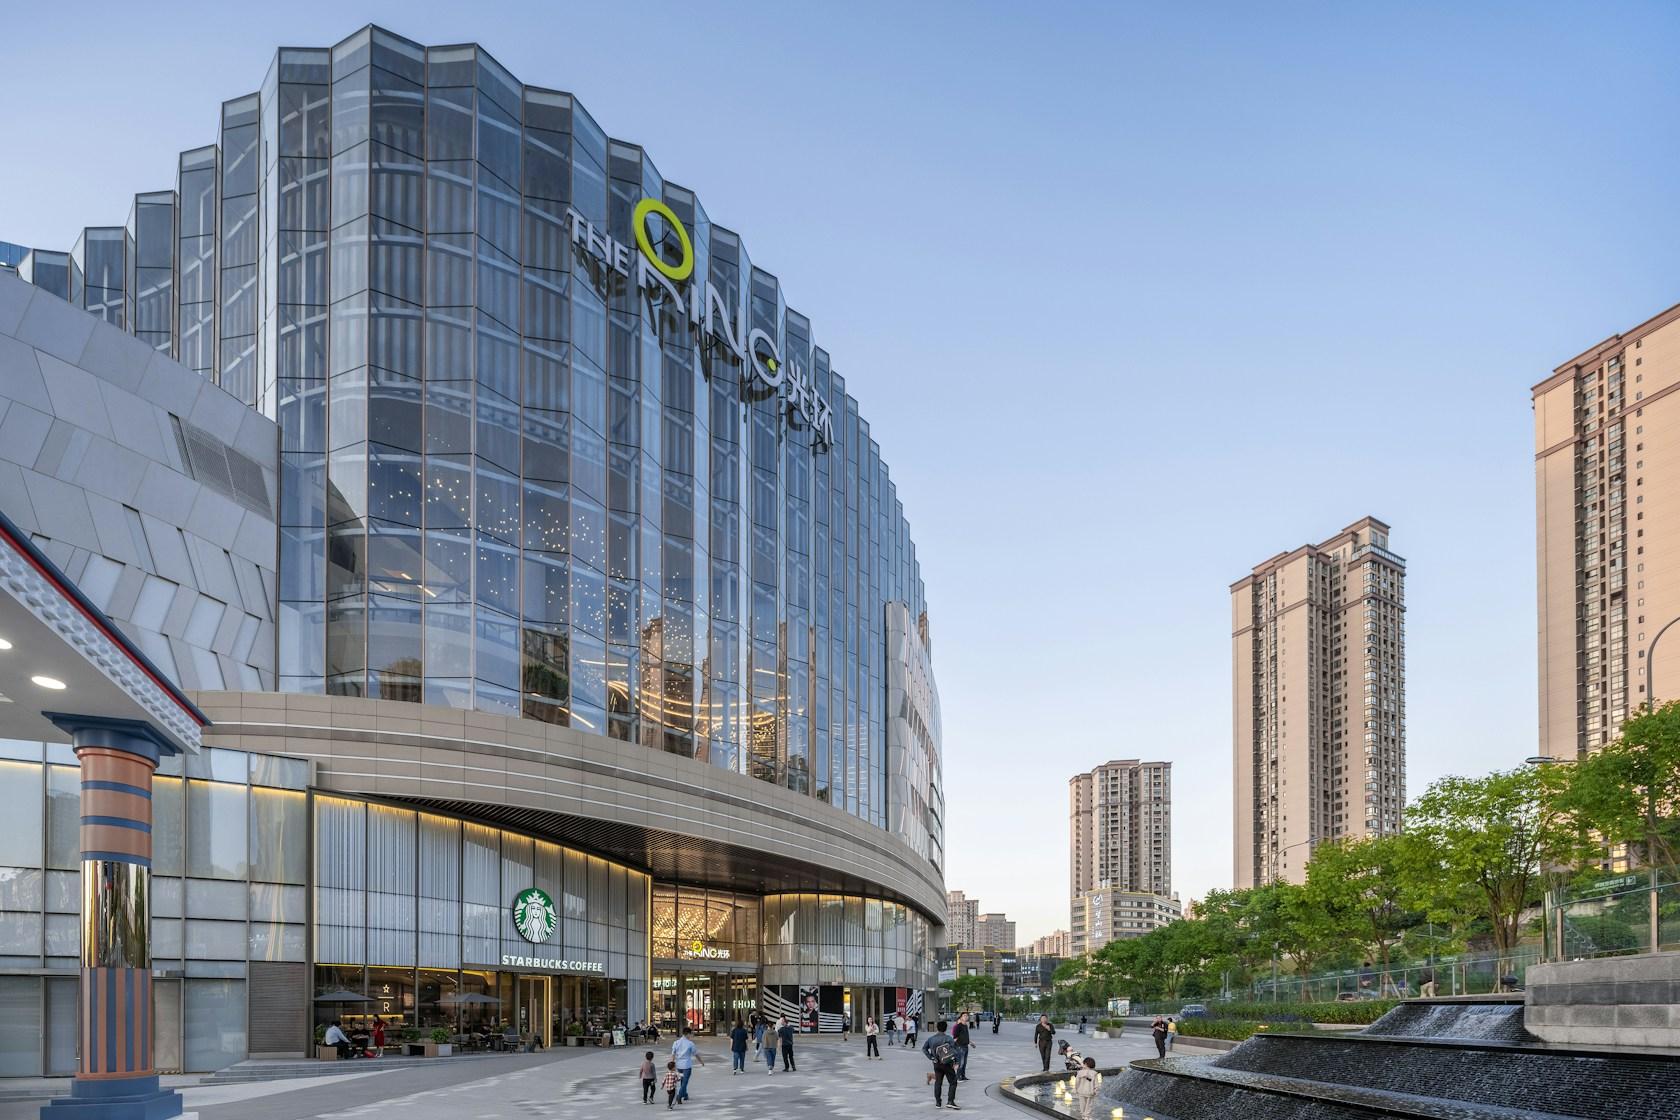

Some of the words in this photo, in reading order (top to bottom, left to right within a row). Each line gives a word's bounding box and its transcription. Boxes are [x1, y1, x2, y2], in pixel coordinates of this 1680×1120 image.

[567, 207, 629, 278] THE
[633, 198, 784, 388] RING
[788, 359, 835, 445] 光环
[692, 941, 718, 958] RING
[502, 954, 568, 970] STARBUCKS
[569, 960, 603, 973] COFFEE
[383, 1001, 390, 1013] R
